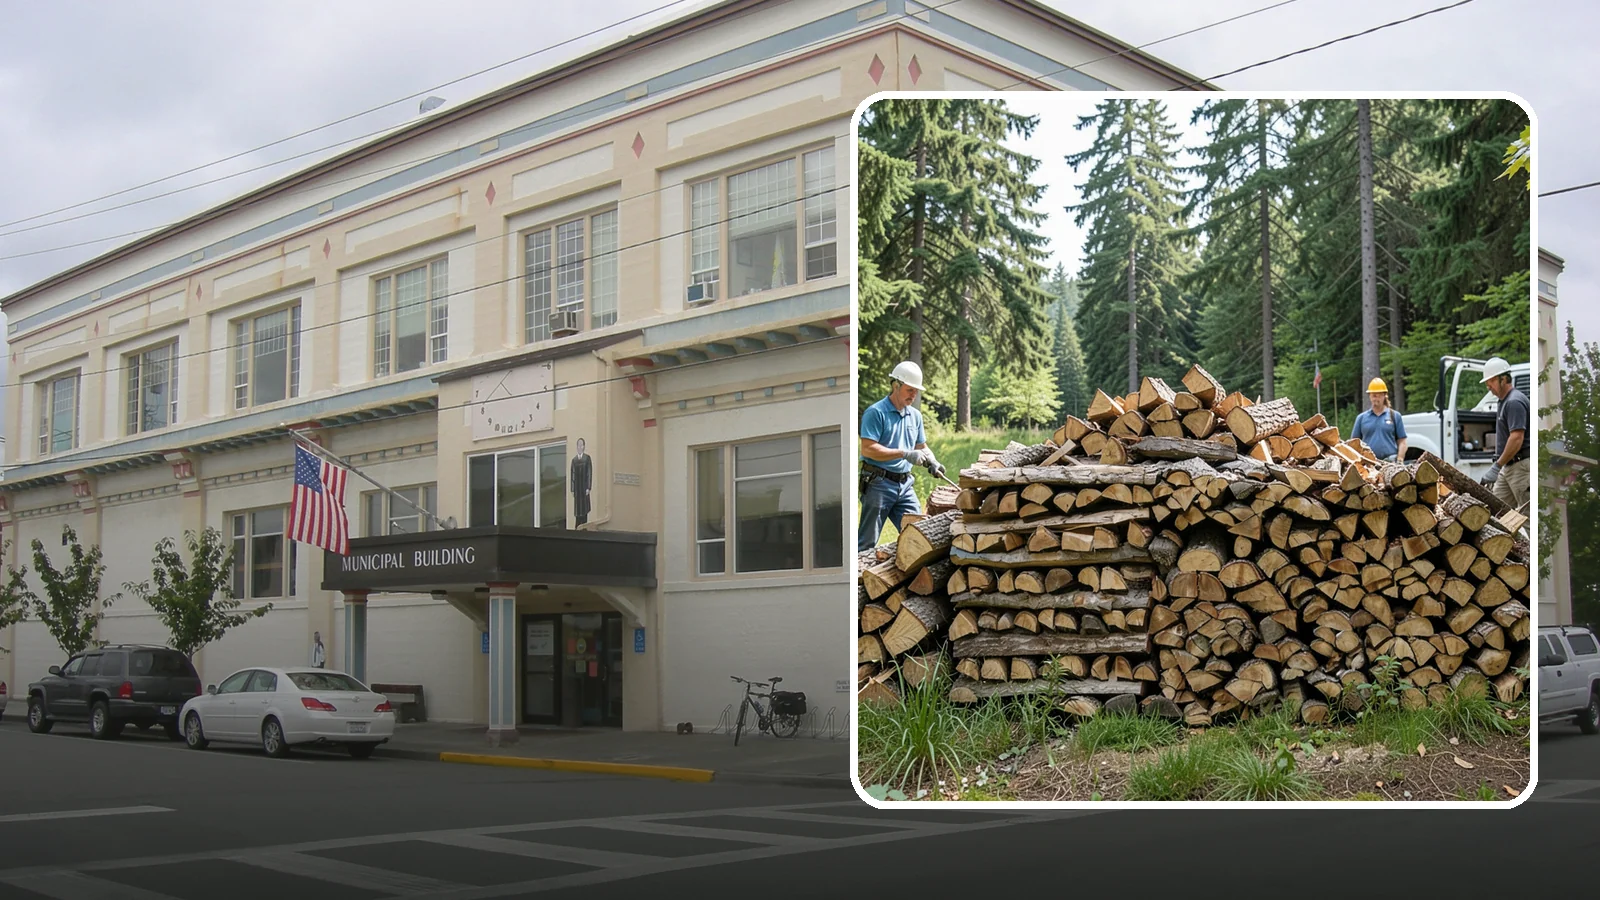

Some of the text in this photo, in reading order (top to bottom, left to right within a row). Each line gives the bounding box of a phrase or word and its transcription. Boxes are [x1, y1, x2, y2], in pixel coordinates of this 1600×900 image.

[481, 407, 485, 415] 8
[488, 417, 492, 425] 9
[495, 423, 500, 431] 10
[507, 425, 513, 433] 12
[521, 420, 525, 428] 2
[529, 413, 533, 422] 3
[536, 402, 540, 410] 4
[342, 546, 475, 572] MUNICIPAL BUILDING
